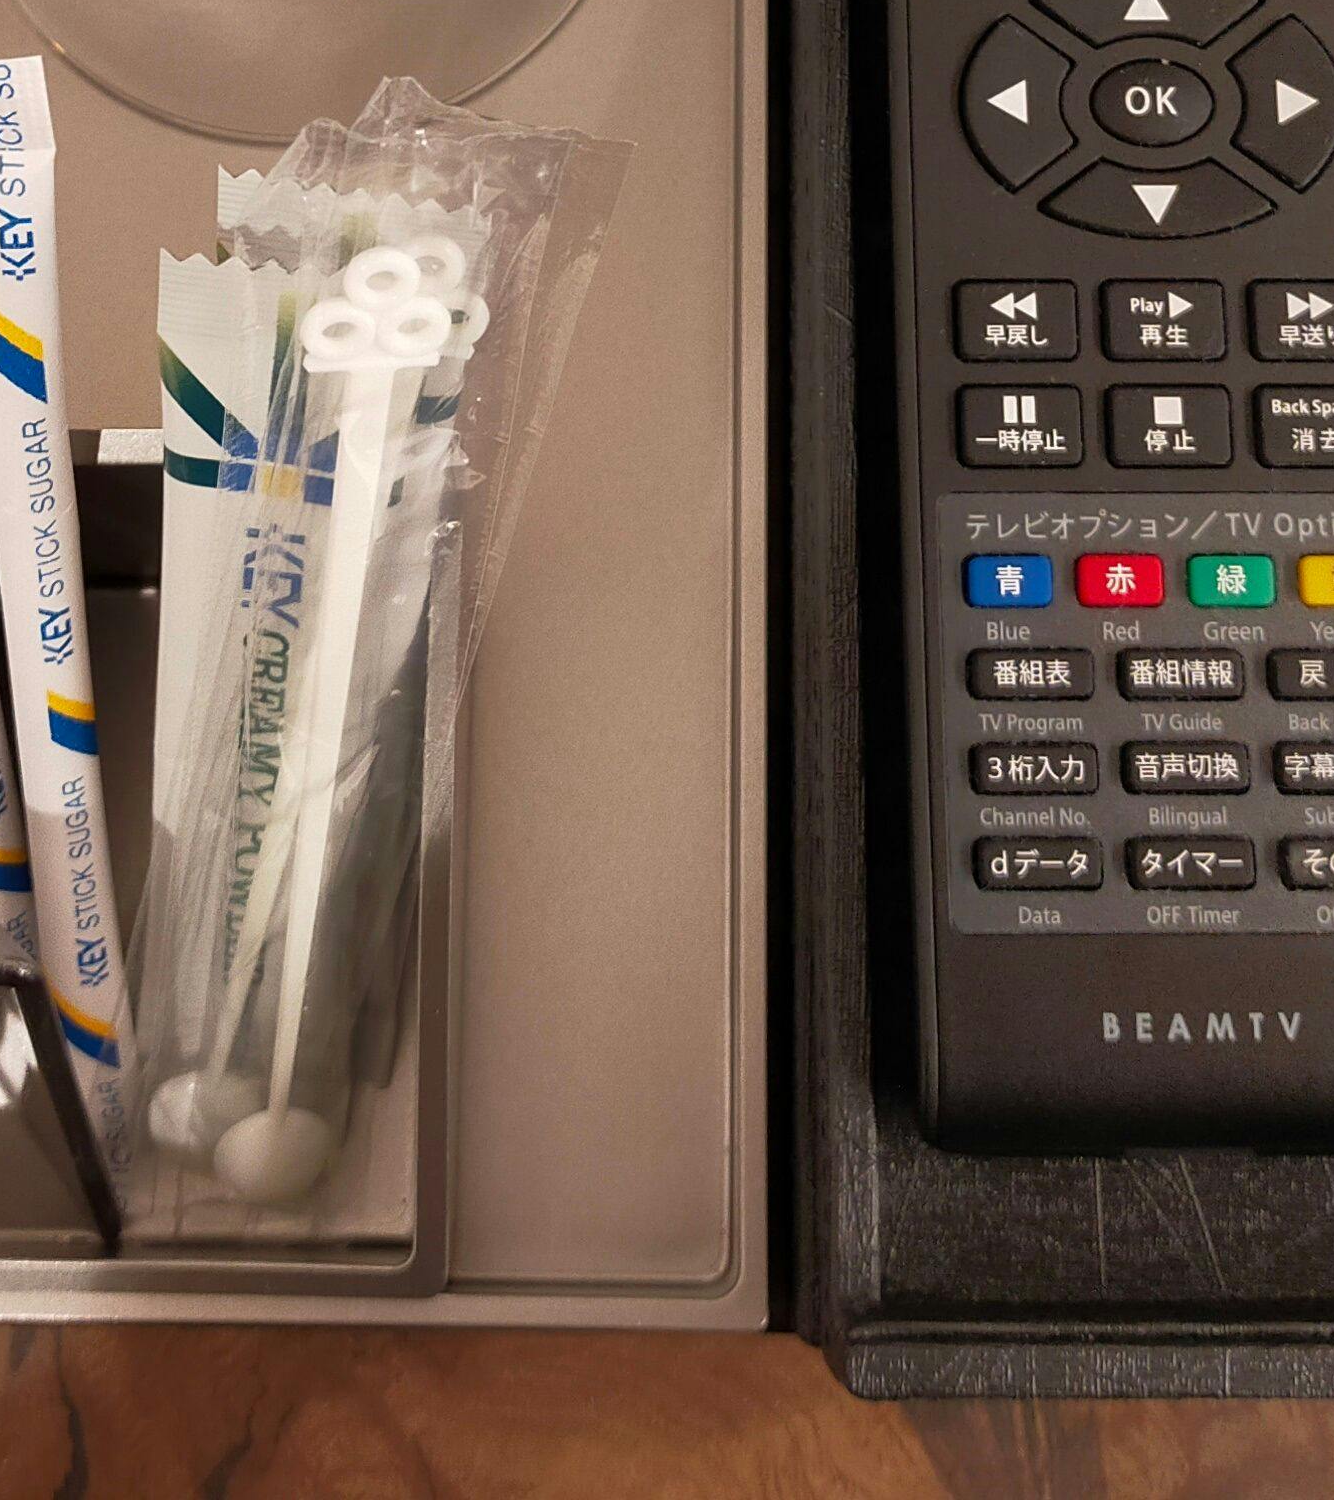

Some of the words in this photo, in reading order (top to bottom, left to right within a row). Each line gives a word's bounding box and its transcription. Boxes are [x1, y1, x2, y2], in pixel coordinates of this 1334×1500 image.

[1124, 86, 1178, 117] OK
[1130, 296, 1164, 317] Play
[985, 325, 1048, 347] 早戻し
[1139, 324, 1189, 347] 再生
[1272, 399, 1310, 415] Back
[975, 430, 1066, 453] 一時停止
[1144, 430, 1195, 453] 停止
[21, 417, 56, 515] SUGAR
[34, 518, 66, 599] STICK
[995, 565, 1024, 596] 青
[1105, 564, 1137, 595] 赤
[1216, 563, 1248, 595] 緑
[39, 605, 74, 665] KEY
[986, 622, 1031, 642] Blue
[1103, 622, 1141, 642] Red
[1203, 622, 1265, 642] Green
[993, 659, 1072, 687] 番組表
[1130, 659, 1233, 687] 番組情報
[979, 713, 1003, 731] TV
[1005, 713, 1083, 735] Program
[1141, 713, 1166, 731] TV
[1169, 713, 1222, 731] Guide
[1288, 713, 1329, 731] Back
[1135, 755, 1239, 784] 音声切換
[62, 775, 93, 860] SUGAR
[980, 807, 1055, 827] Channel
[1058, 807, 1092, 827] No.
[1148, 807, 1227, 831] Bilingual
[990, 849, 1089, 878] dデータ
[1141, 849, 1244, 878] タイマー
[66, 863, 101, 932] STICK
[1018, 906, 1061, 925] Data
[1146, 906, 1182, 925] OFF
[1189, 906, 1241, 925] Timer
[75, 936, 109, 987] KEY
[1102, 1011, 1301, 1044] BEAMTV
